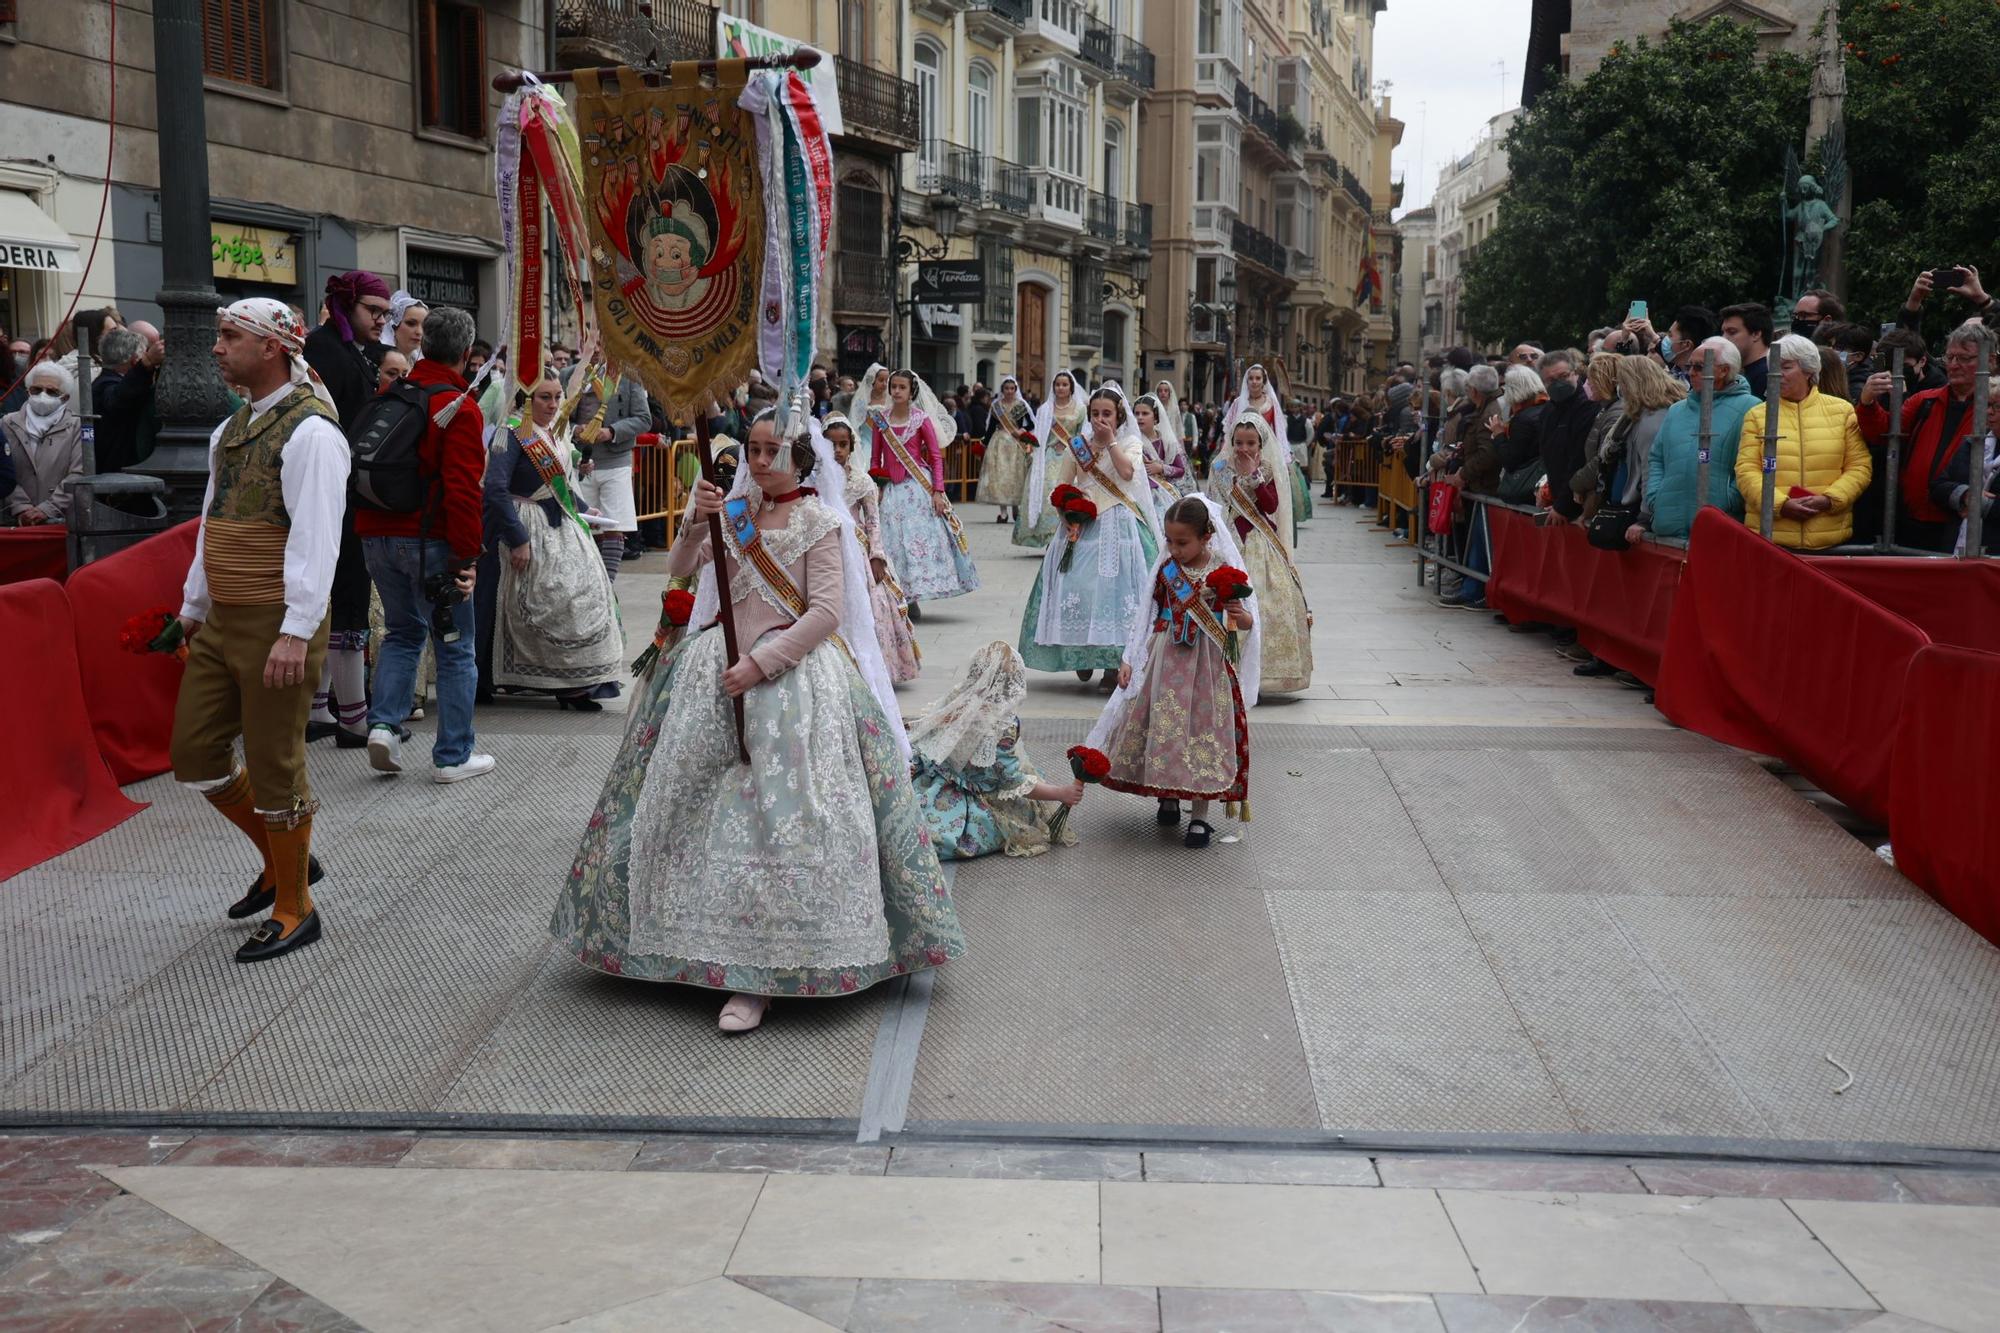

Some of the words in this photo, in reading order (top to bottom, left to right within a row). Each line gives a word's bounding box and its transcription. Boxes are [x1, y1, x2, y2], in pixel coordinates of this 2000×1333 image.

[522, 176, 537, 218] Fallera
[525, 224, 539, 258] Major
[525, 263, 540, 309] Infantil
[940, 270, 981, 282] Terrazza
[524, 314, 536, 339] 2017
[608, 300, 630, 326] GIL
